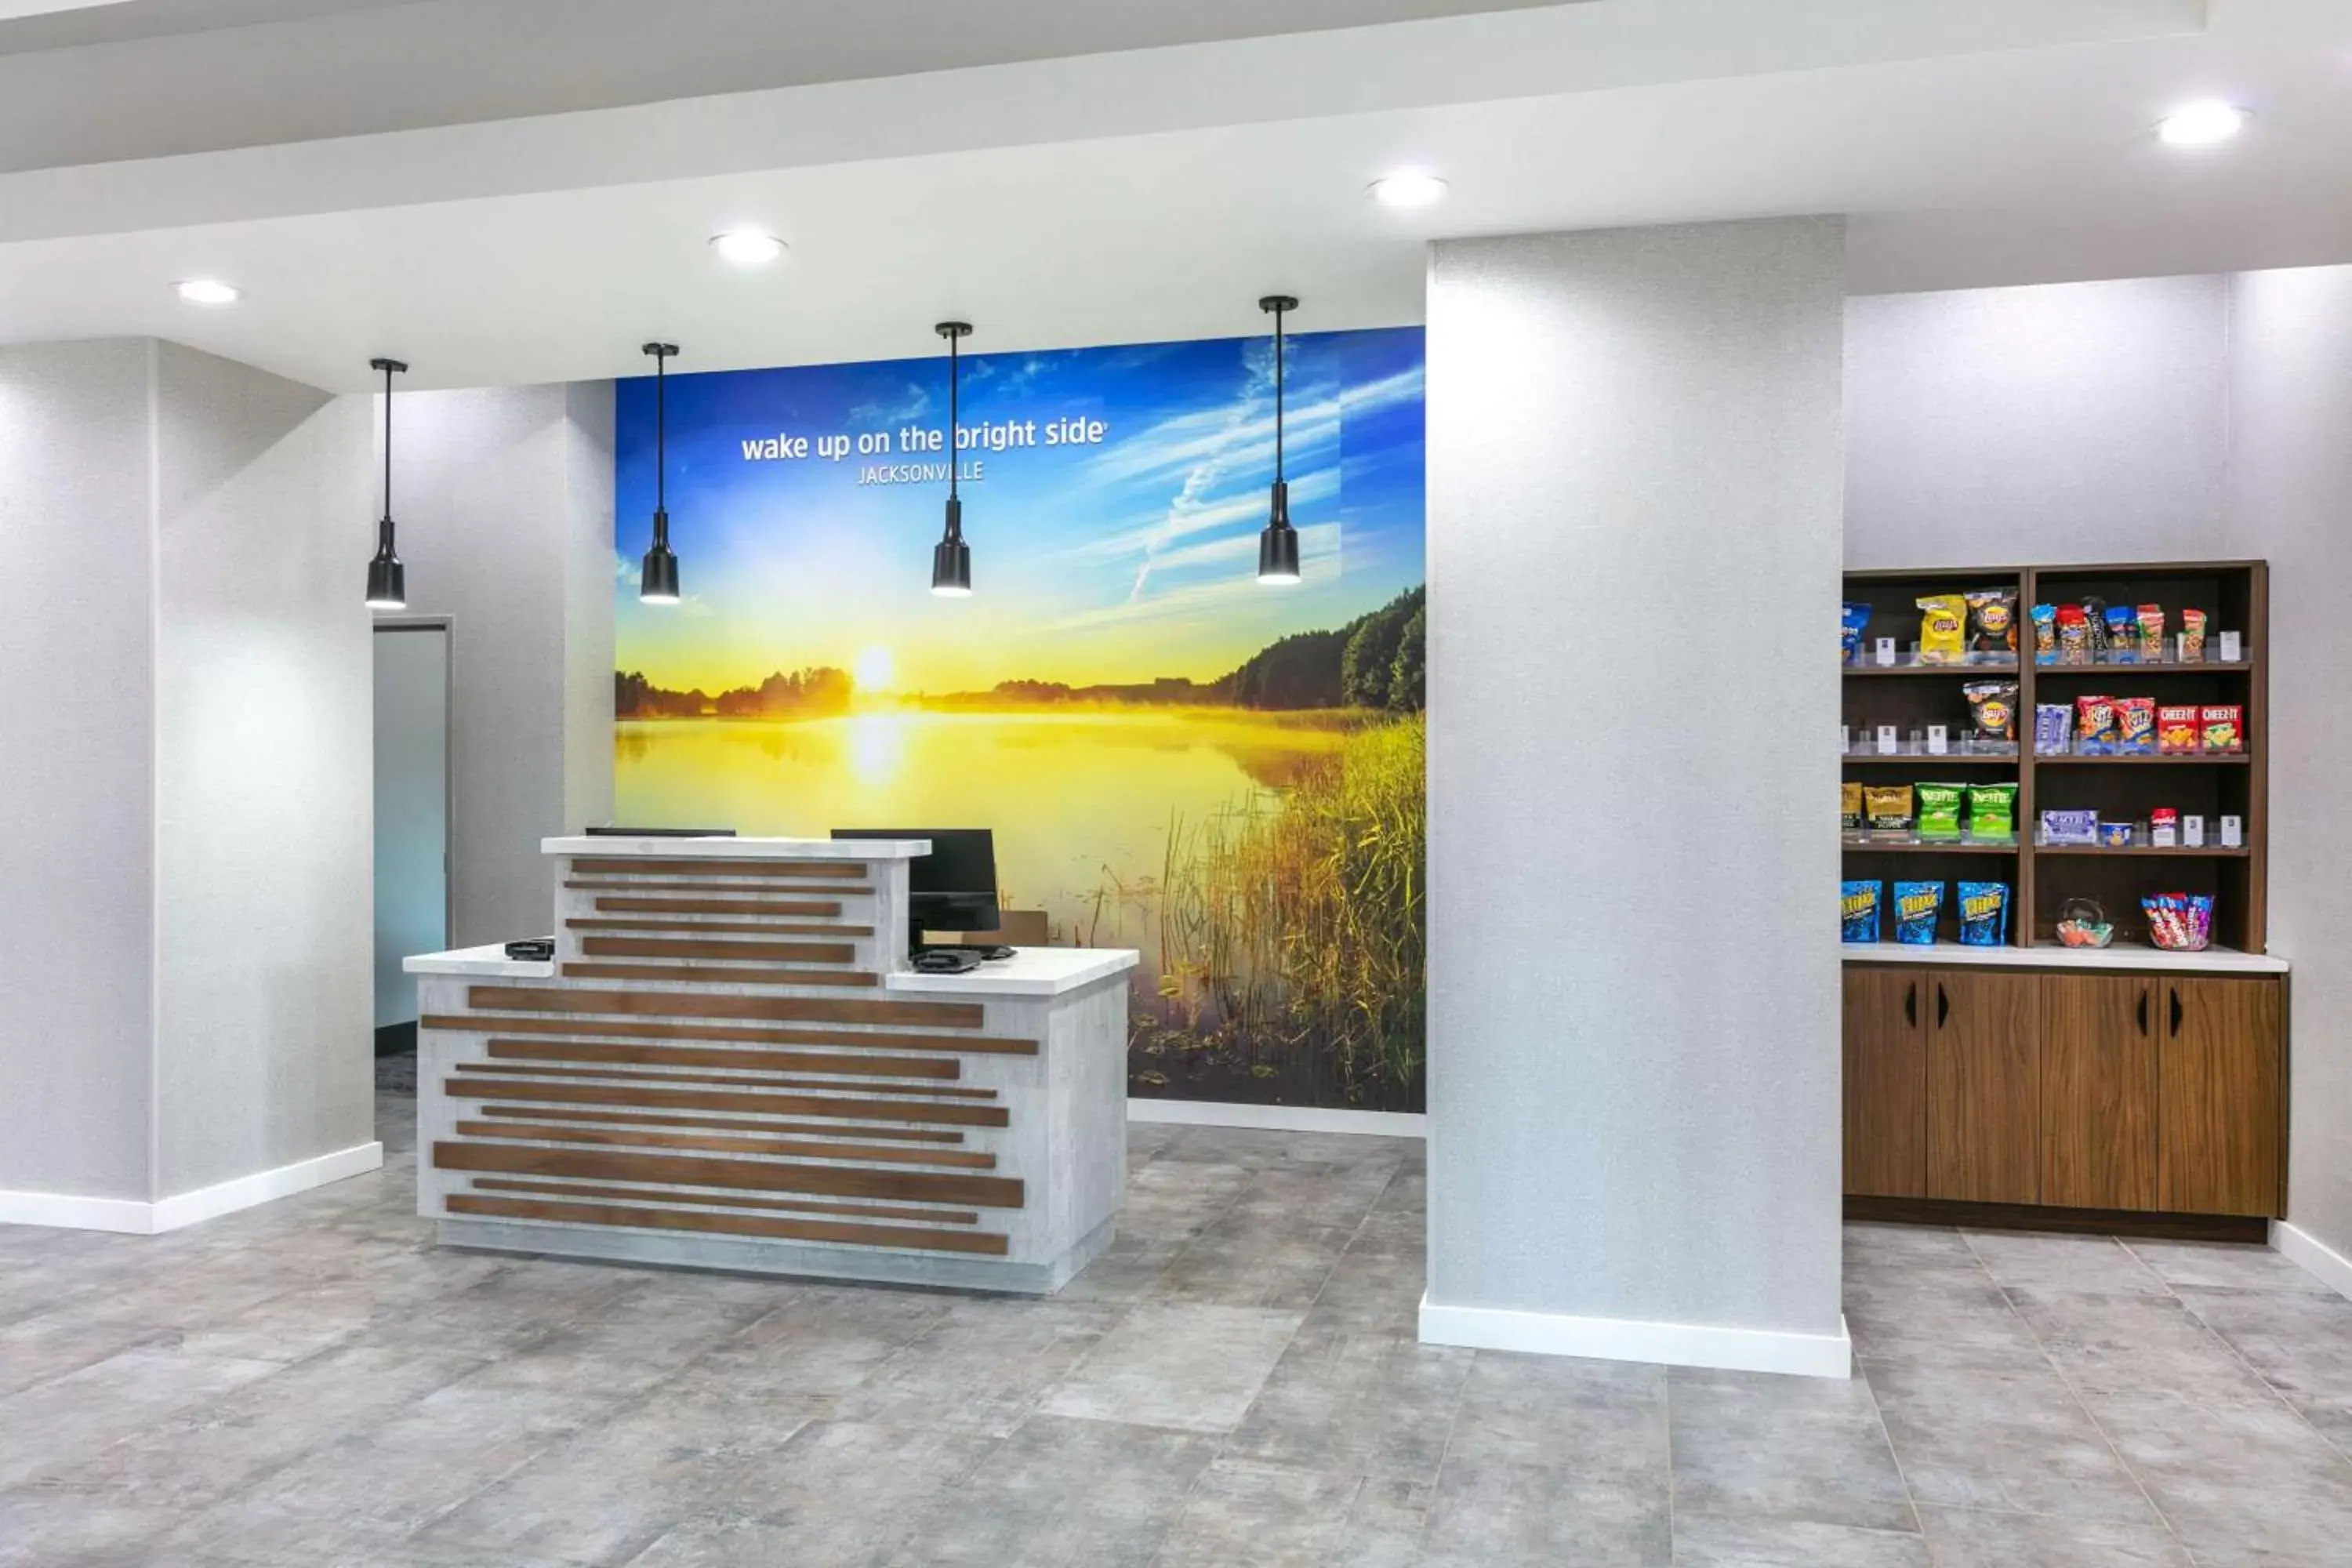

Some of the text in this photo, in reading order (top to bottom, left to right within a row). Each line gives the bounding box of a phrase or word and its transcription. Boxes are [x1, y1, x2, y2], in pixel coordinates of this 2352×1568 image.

[742, 432, 808, 461] wake
[818, 434, 851, 462] up
[858, 432, 890, 454] on
[900, 425, 943, 452] the
[955, 419, 1036, 452] bright
